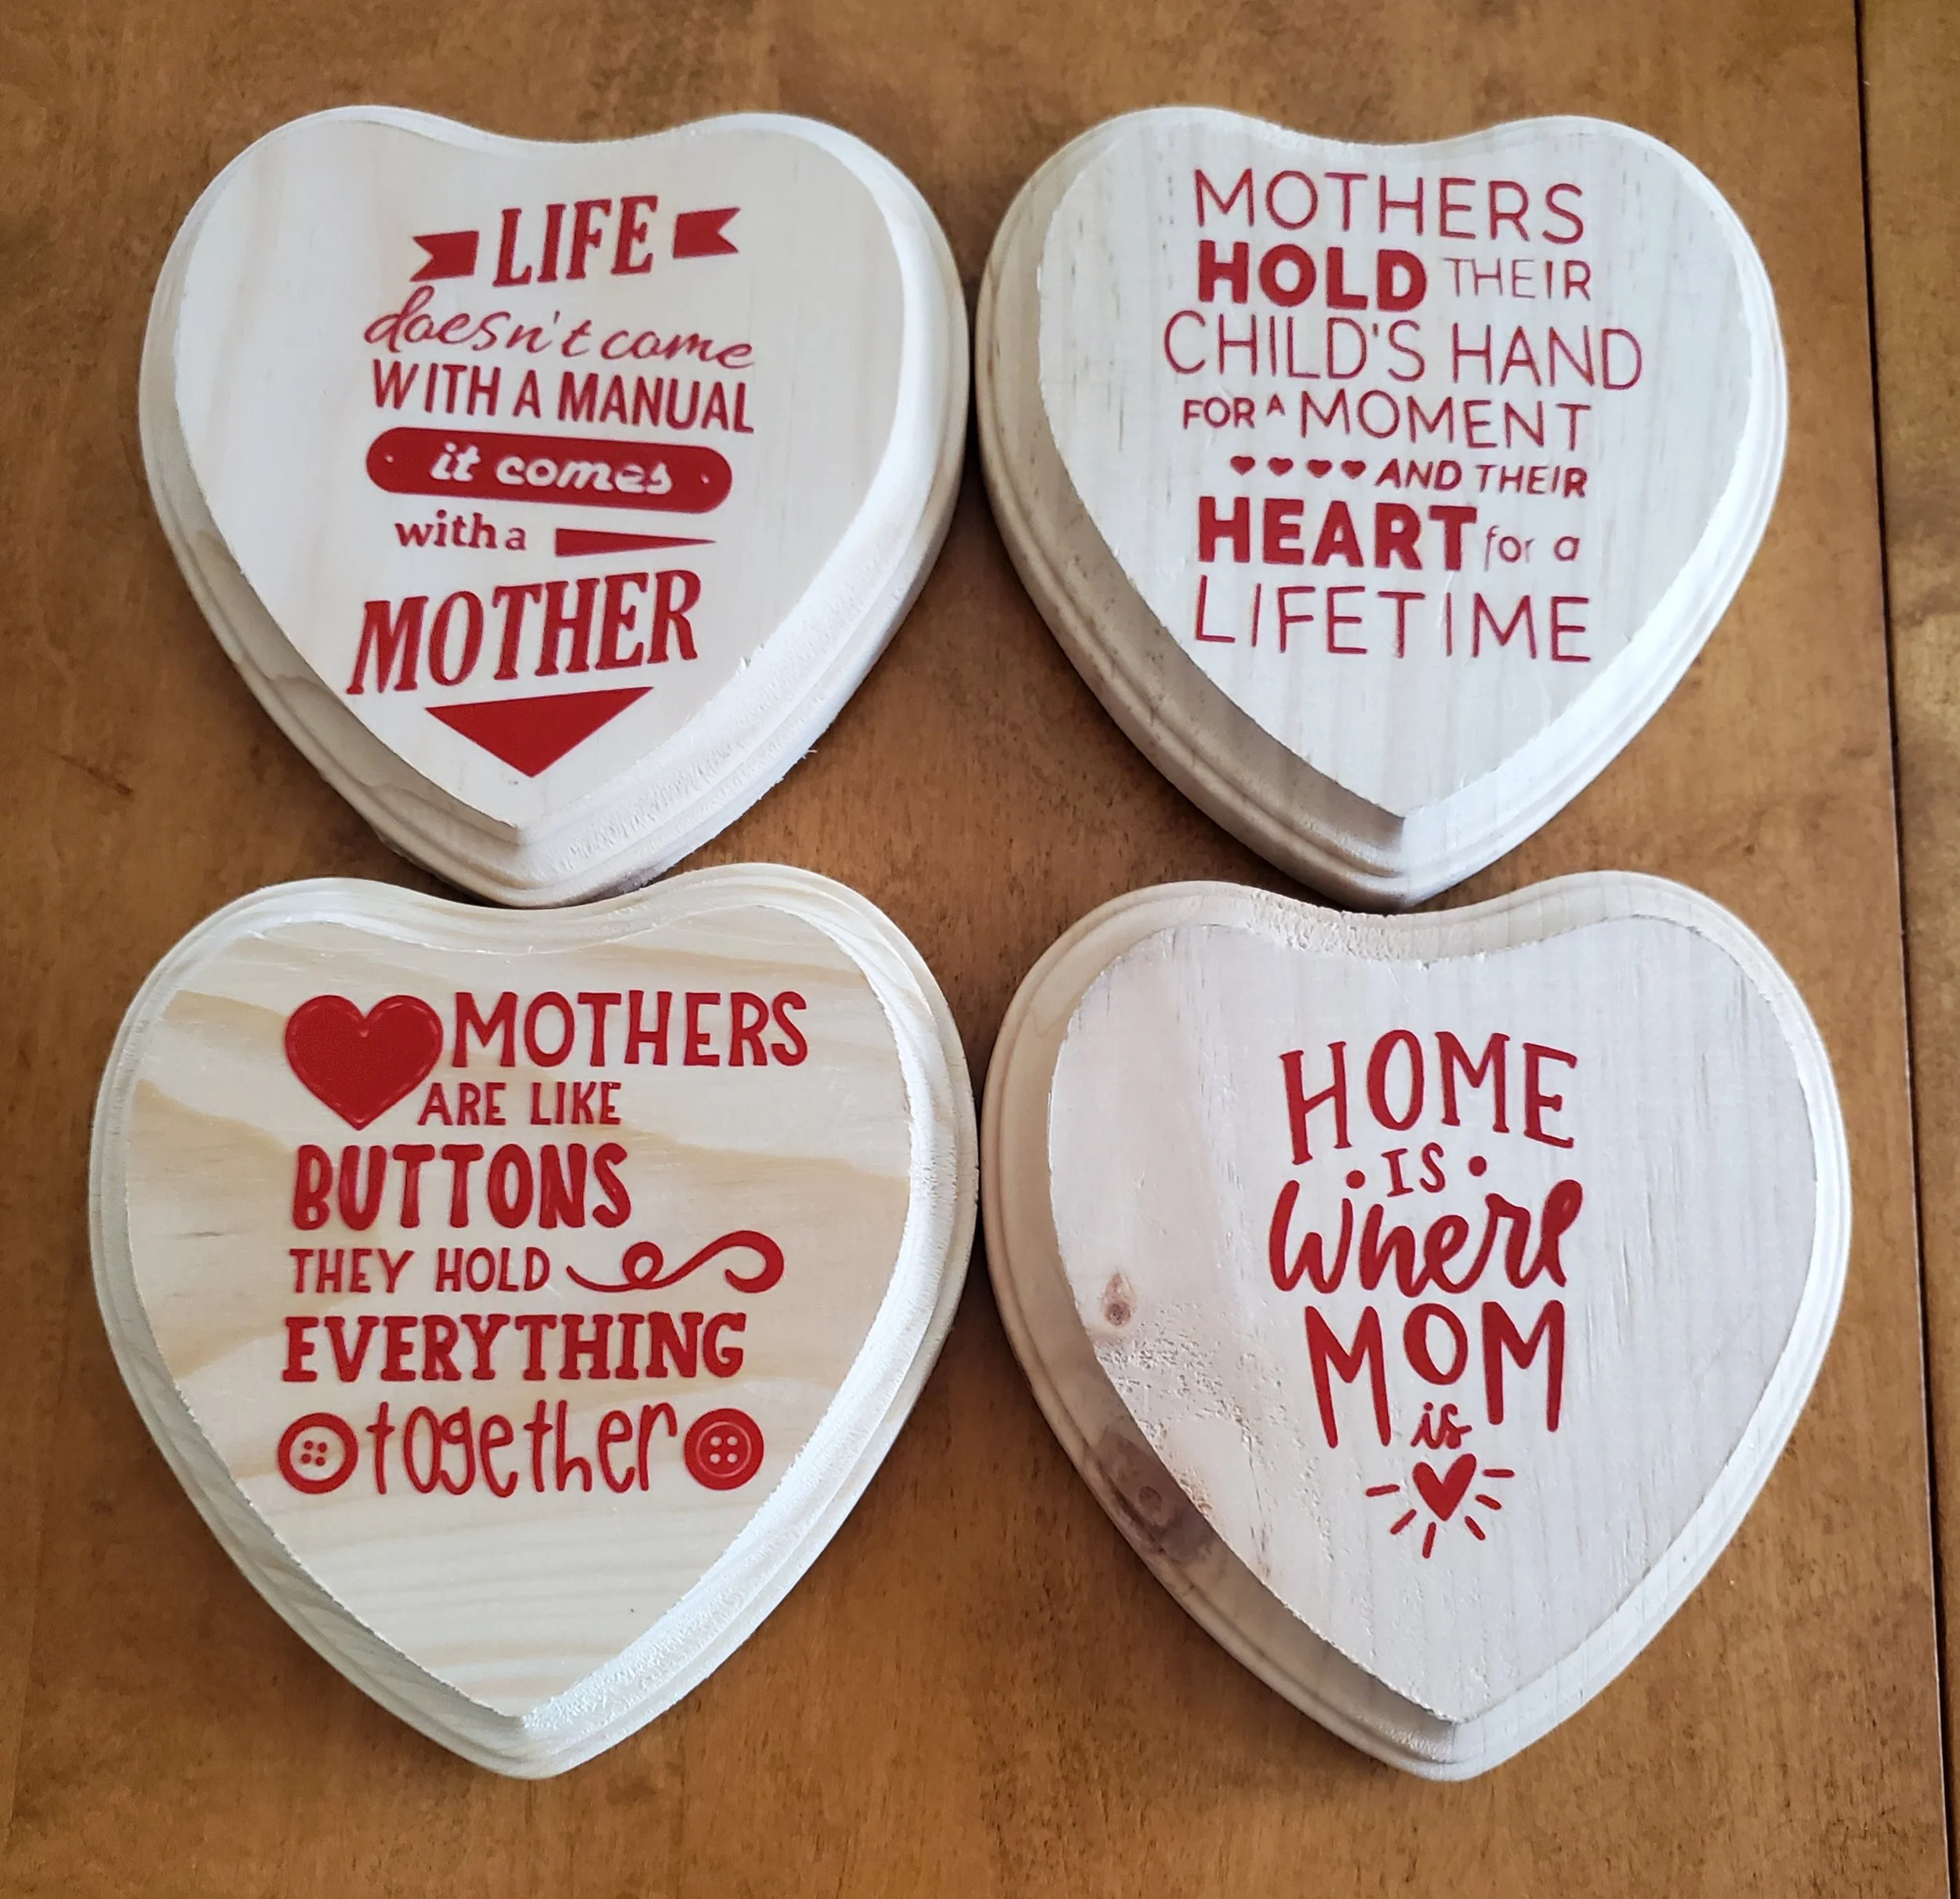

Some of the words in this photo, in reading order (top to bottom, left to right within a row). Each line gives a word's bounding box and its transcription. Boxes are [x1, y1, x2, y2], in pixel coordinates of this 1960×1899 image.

[492, 194, 659, 287] LIFE
[1194, 169, 1584, 245] MOTHERS
[1197, 240, 1428, 311] HOLD
[1444, 256, 1592, 300] THEIR
[364, 285, 592, 357] doesn't
[599, 329, 754, 370] come
[1163, 310, 1425, 383] CHILD'S
[1450, 325, 1642, 391] HAND
[372, 358, 500, 416] WITH
[514, 370, 542, 417] A
[557, 371, 754, 434] MANUAL
[1182, 399, 1256, 430] FOR
[1266, 394, 1284, 412] A
[1299, 389, 1592, 452] MOMENT
[430, 441, 479, 485] it
[495, 453, 673, 496] comes
[1374, 459, 1463, 490] AND
[1476, 463, 1588, 497] THEIR
[395, 510, 498, 550] with
[503, 528, 527, 550] a
[1198, 495, 1478, 572] HEART
[1485, 525, 1534, 571] for
[1554, 535, 1580, 563] a
[346, 571, 702, 696] MOTHER
[1195, 575, 1593, 663] LIFETIME
[450, 989, 809, 1069] MOTHERS
[416, 1080, 508, 1127] ARE
[528, 1080, 623, 1127] LIKE
[1279, 1028, 1579, 1167] HOME
[291, 1141, 633, 1232] BUTTONS
[1382, 1141, 1448, 1198] IS
[288, 1247, 416, 1294] THEY
[434, 1246, 552, 1294] HOLD
[281, 1310, 749, 1385] EVERYTHING
[1303, 1298, 1566, 1450] MOM
[365, 1399, 679, 1500] together
[1410, 1400, 1472, 1451] is
